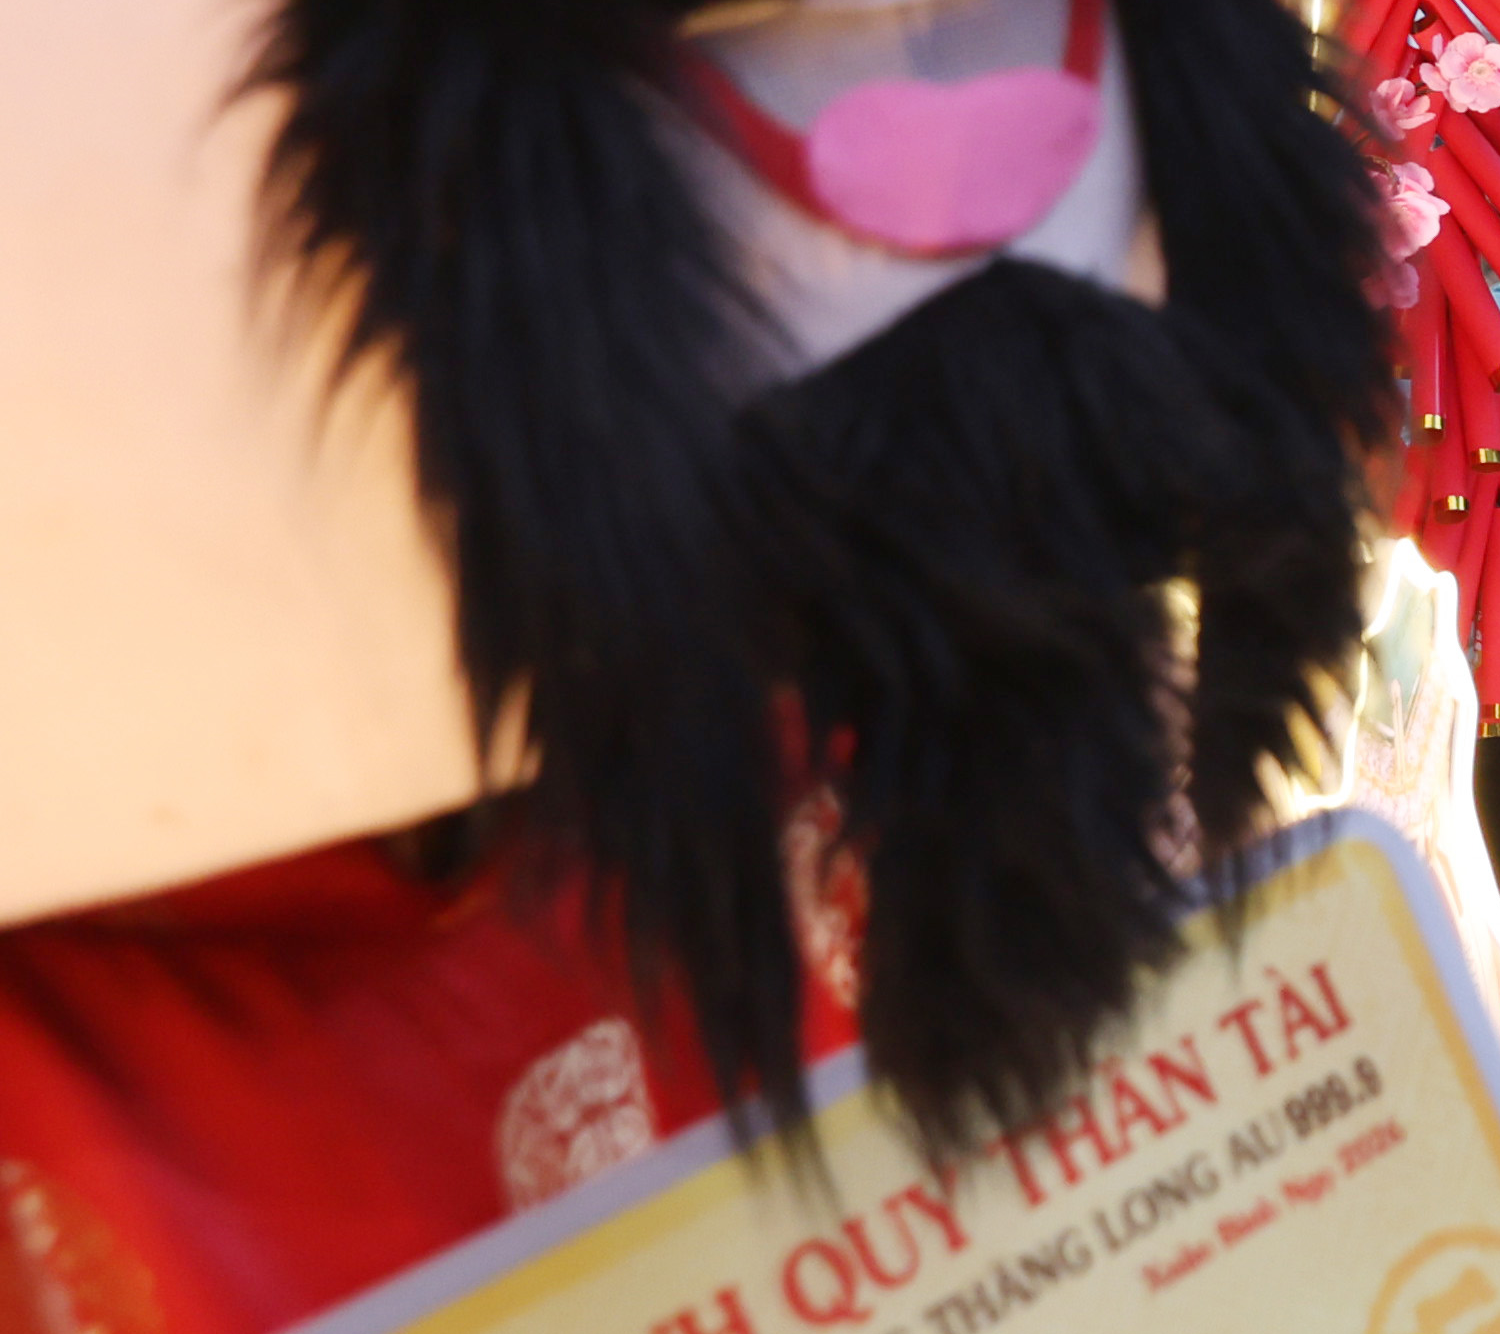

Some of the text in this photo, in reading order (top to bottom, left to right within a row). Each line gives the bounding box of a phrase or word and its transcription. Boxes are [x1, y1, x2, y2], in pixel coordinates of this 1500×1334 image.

[988, 1035, 1215, 1208] THẦN
[1217, 959, 1355, 1079] TÀI
[1092, 1155, 1223, 1254] LONG
